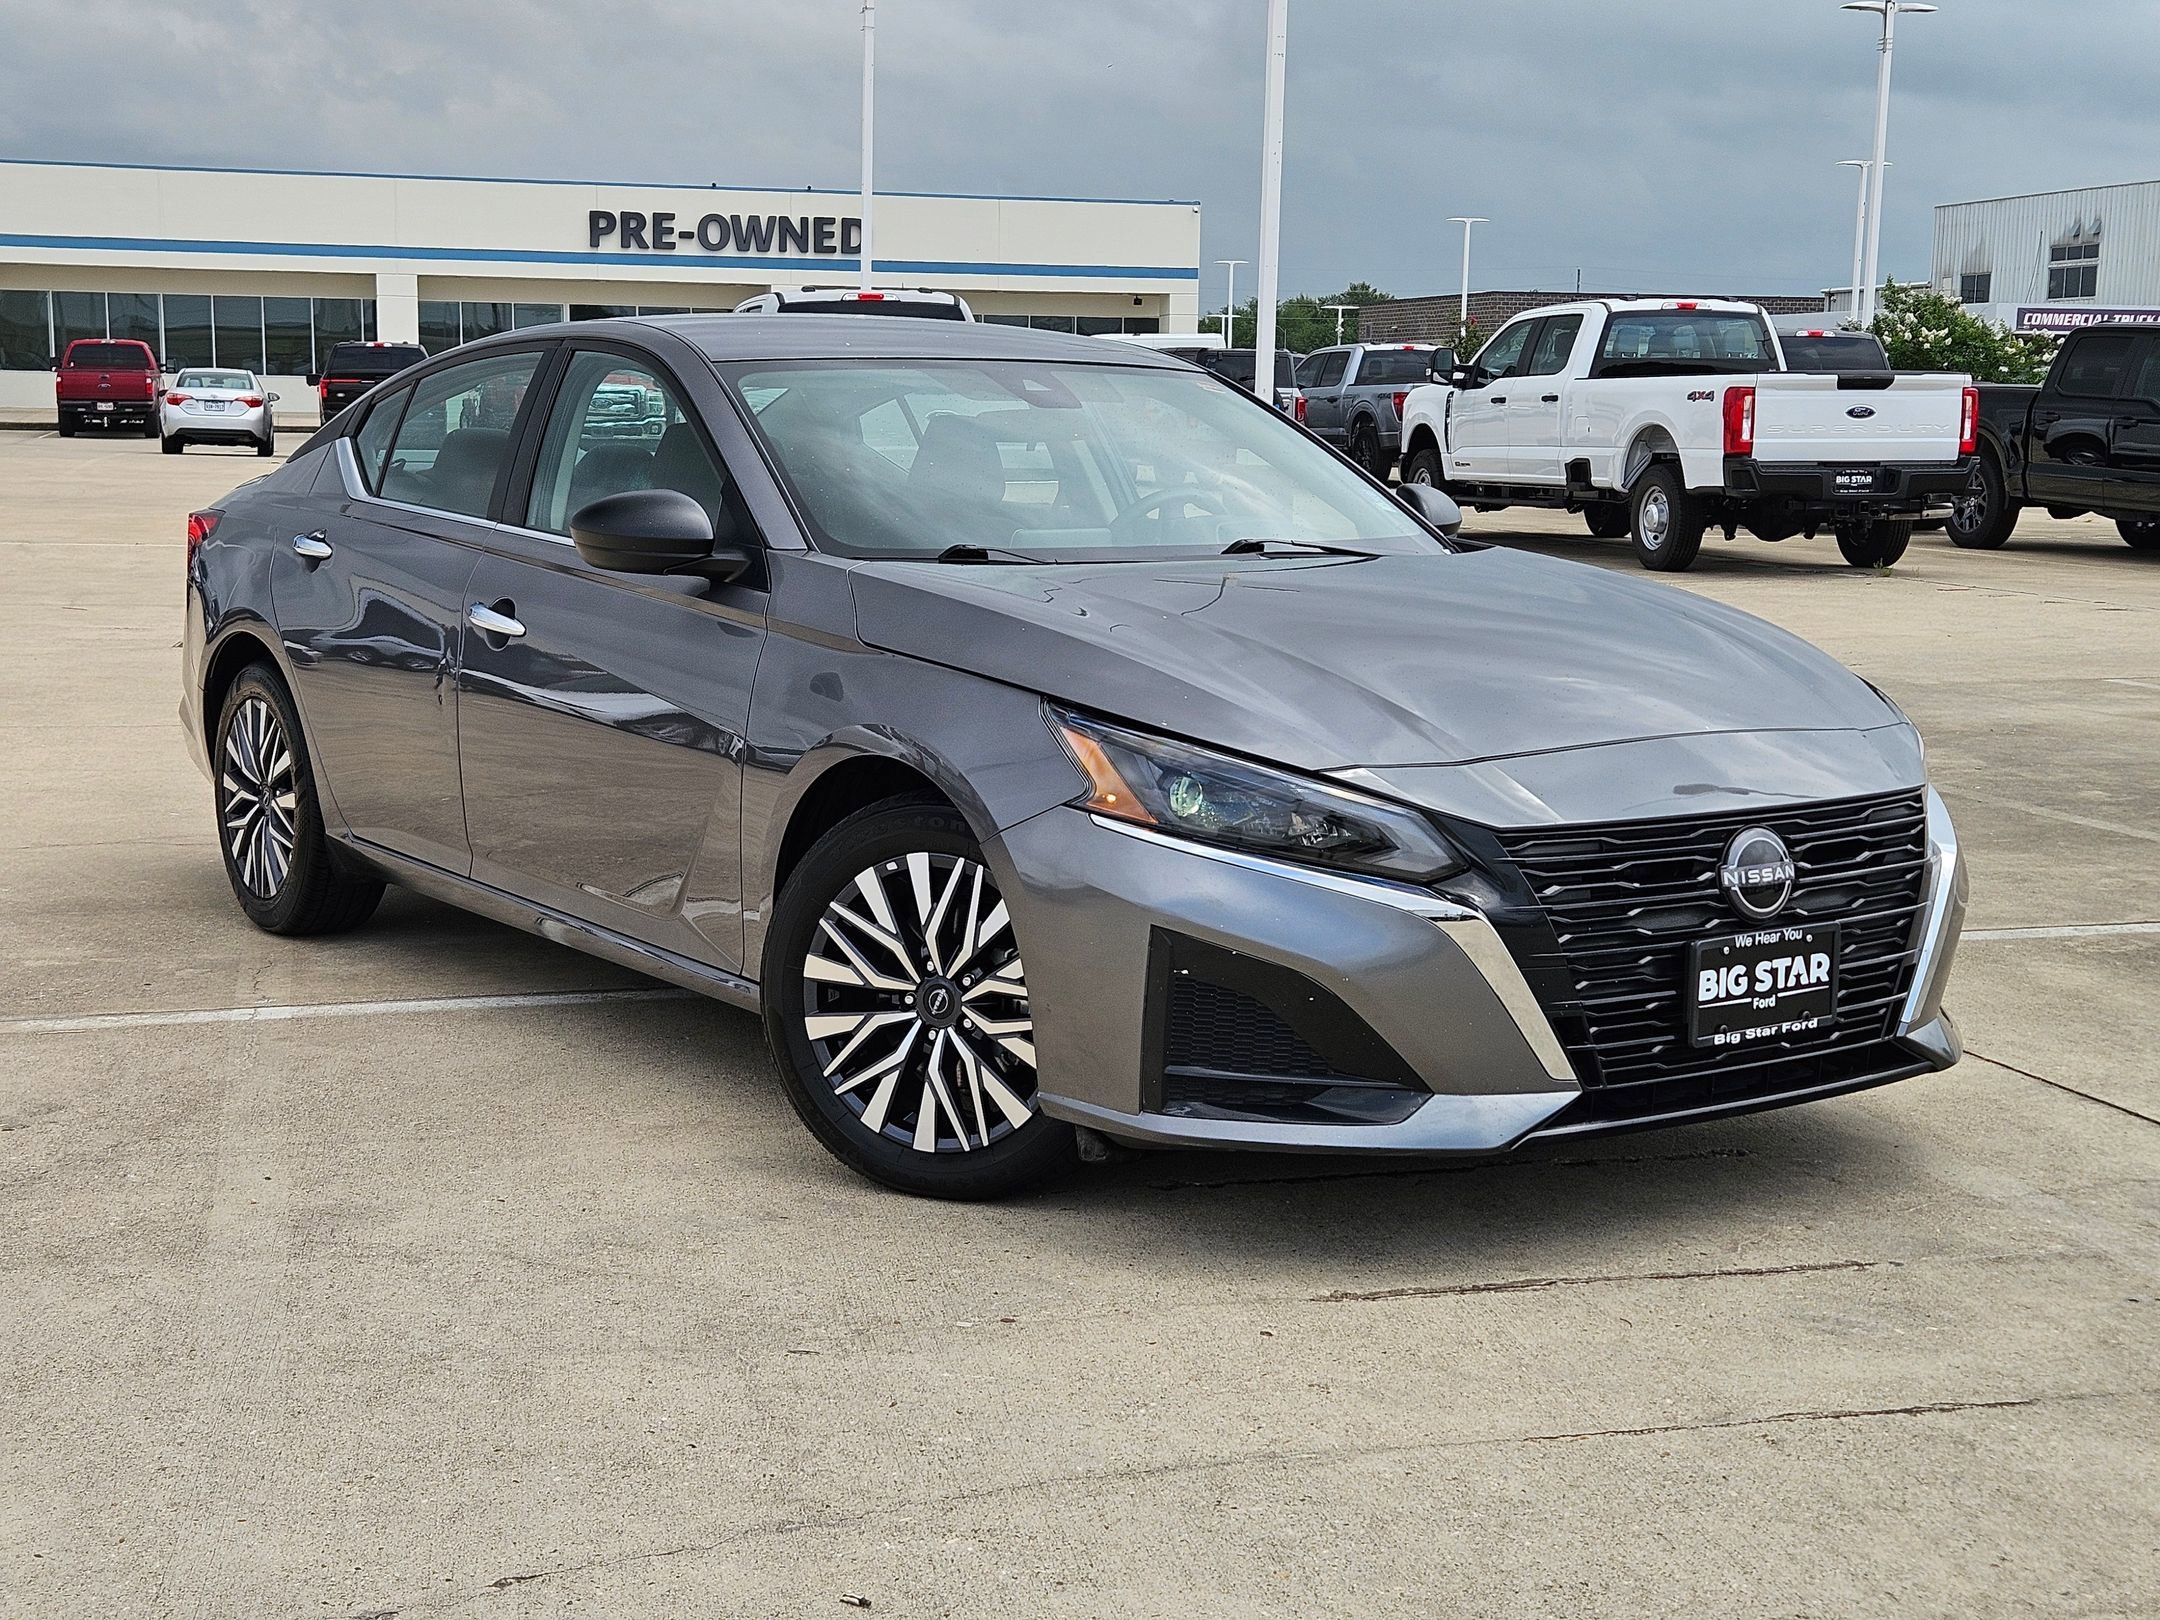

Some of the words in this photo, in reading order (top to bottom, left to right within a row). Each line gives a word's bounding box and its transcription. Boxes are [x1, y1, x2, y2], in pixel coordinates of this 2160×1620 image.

[589, 210, 861, 254] PRE-OWNED
[2023, 313, 2109, 326] COMMERCIAL
[1767, 424, 1868, 434] SUPER
[1876, 424, 1950, 433] DUTY
[1836, 475, 1850, 483] BIG
[1851, 475, 1872, 483] STAR
[1723, 864, 1795, 885] NISSAN
[1734, 935, 1753, 948] We
[1755, 932, 1781, 945] Hear
[1783, 929, 1802, 941] You
[1698, 964, 1748, 1001] BIG
[1754, 953, 1830, 992] STAR
[1753, 994, 1776, 1010] Ford
[1714, 1031, 1740, 1045] Big
[1745, 1026, 1778, 1039] Star
[1781, 1018, 1818, 1033] Ford
